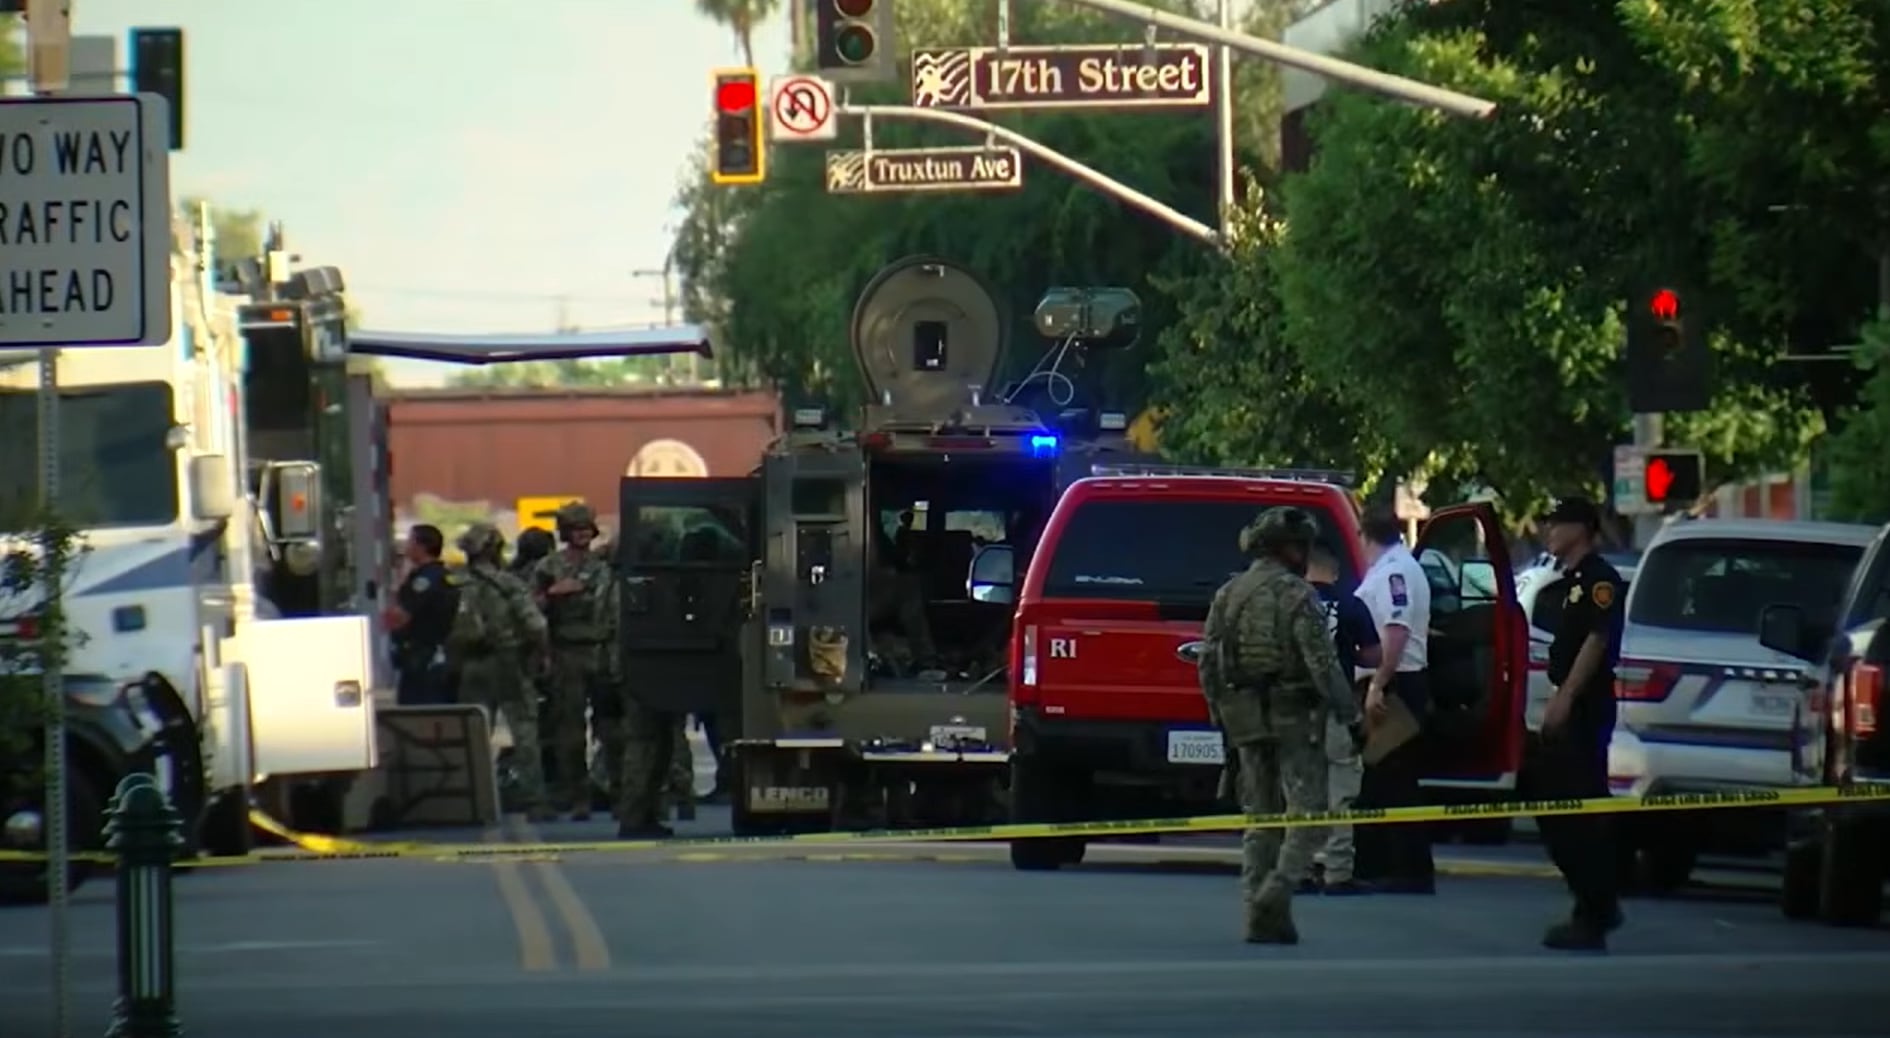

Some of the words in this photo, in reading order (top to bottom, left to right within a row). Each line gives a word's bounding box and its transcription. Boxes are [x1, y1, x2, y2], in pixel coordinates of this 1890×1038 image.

[988, 58, 1063, 95] 17th
[1078, 56, 1197, 93] Street
[54, 131, 131, 174] WAY
[873, 157, 963, 182] Truxtun
[970, 155, 1010, 180] Ave
[0, 269, 114, 314] HEAD
[1172, 743, 1222, 759] 170905
